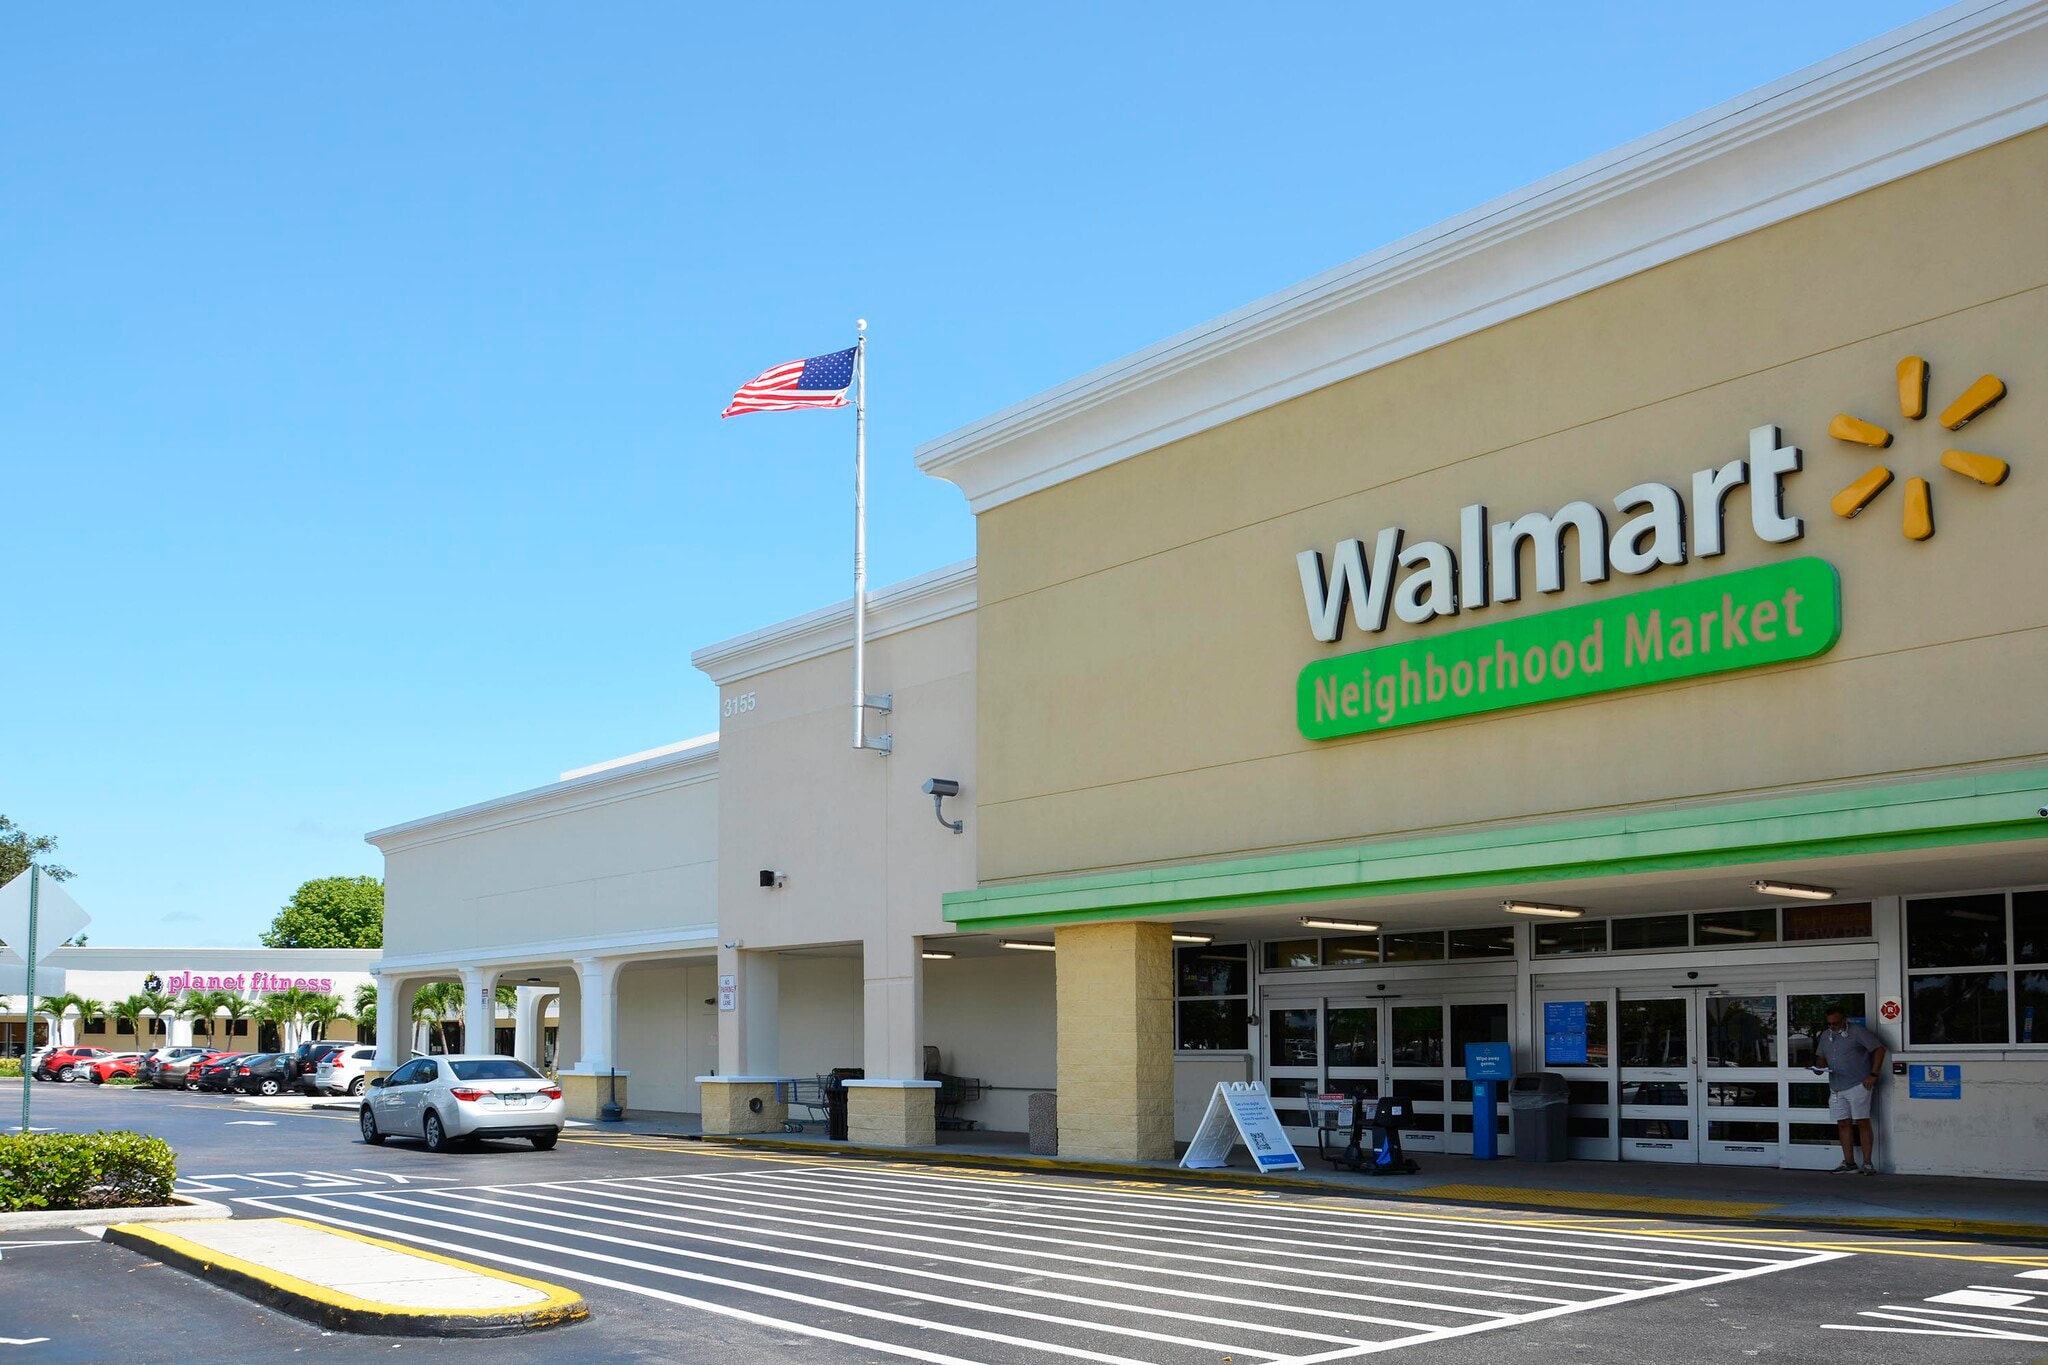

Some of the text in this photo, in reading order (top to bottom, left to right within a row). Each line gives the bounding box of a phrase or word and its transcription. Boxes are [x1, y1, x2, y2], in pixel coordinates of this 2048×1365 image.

[1296, 423, 1804, 643] Walmart
[1314, 588, 1805, 724] Neighborhood Market
[723, 691, 756, 717] 3155
[168, 971, 332, 994] planet fitness
